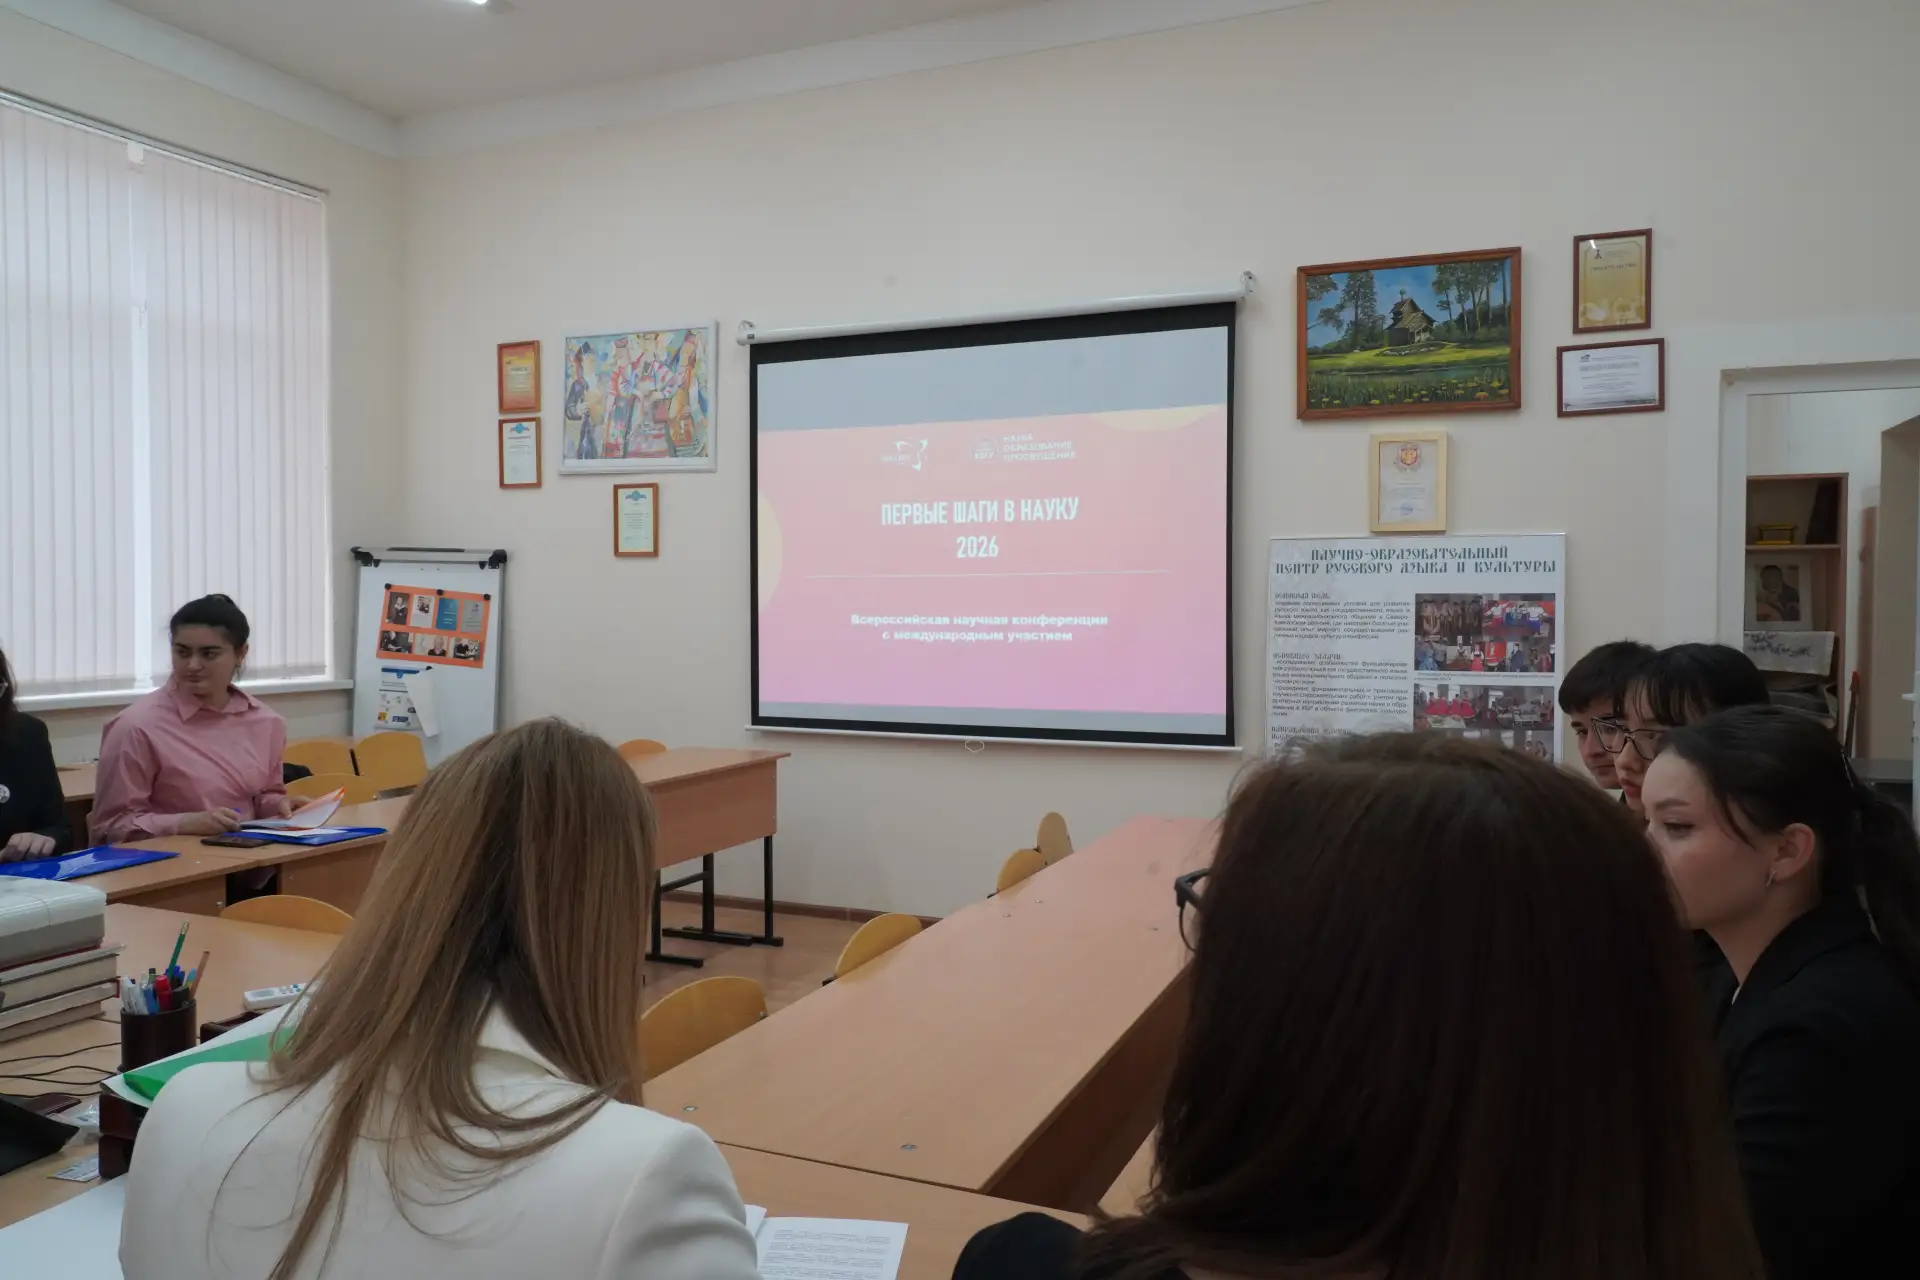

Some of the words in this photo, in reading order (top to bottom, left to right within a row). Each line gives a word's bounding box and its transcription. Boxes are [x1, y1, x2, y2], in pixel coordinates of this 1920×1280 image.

[881, 502, 948, 525] ПЕРВЫЕ
[953, 500, 998, 523] ШАГИ
[1004, 499, 1015, 522] В
[1020, 496, 1079, 521] НАУКУ
[956, 535, 999, 558] 2026
[1276, 562, 1320, 574] ЦЕНТР
[1326, 562, 1393, 574] РУССКОГО
[1400, 562, 1448, 574] ЯЗЫКА
[1456, 561, 1465, 573] И
[1475, 560, 1556, 573] КУЛЬТУРЫ
[851, 614, 950, 628] Всероссийская
[954, 615, 1009, 628] научная
[883, 631, 890, 640] с
[893, 631, 1004, 644] международным
[1007, 632, 1073, 644] участием
